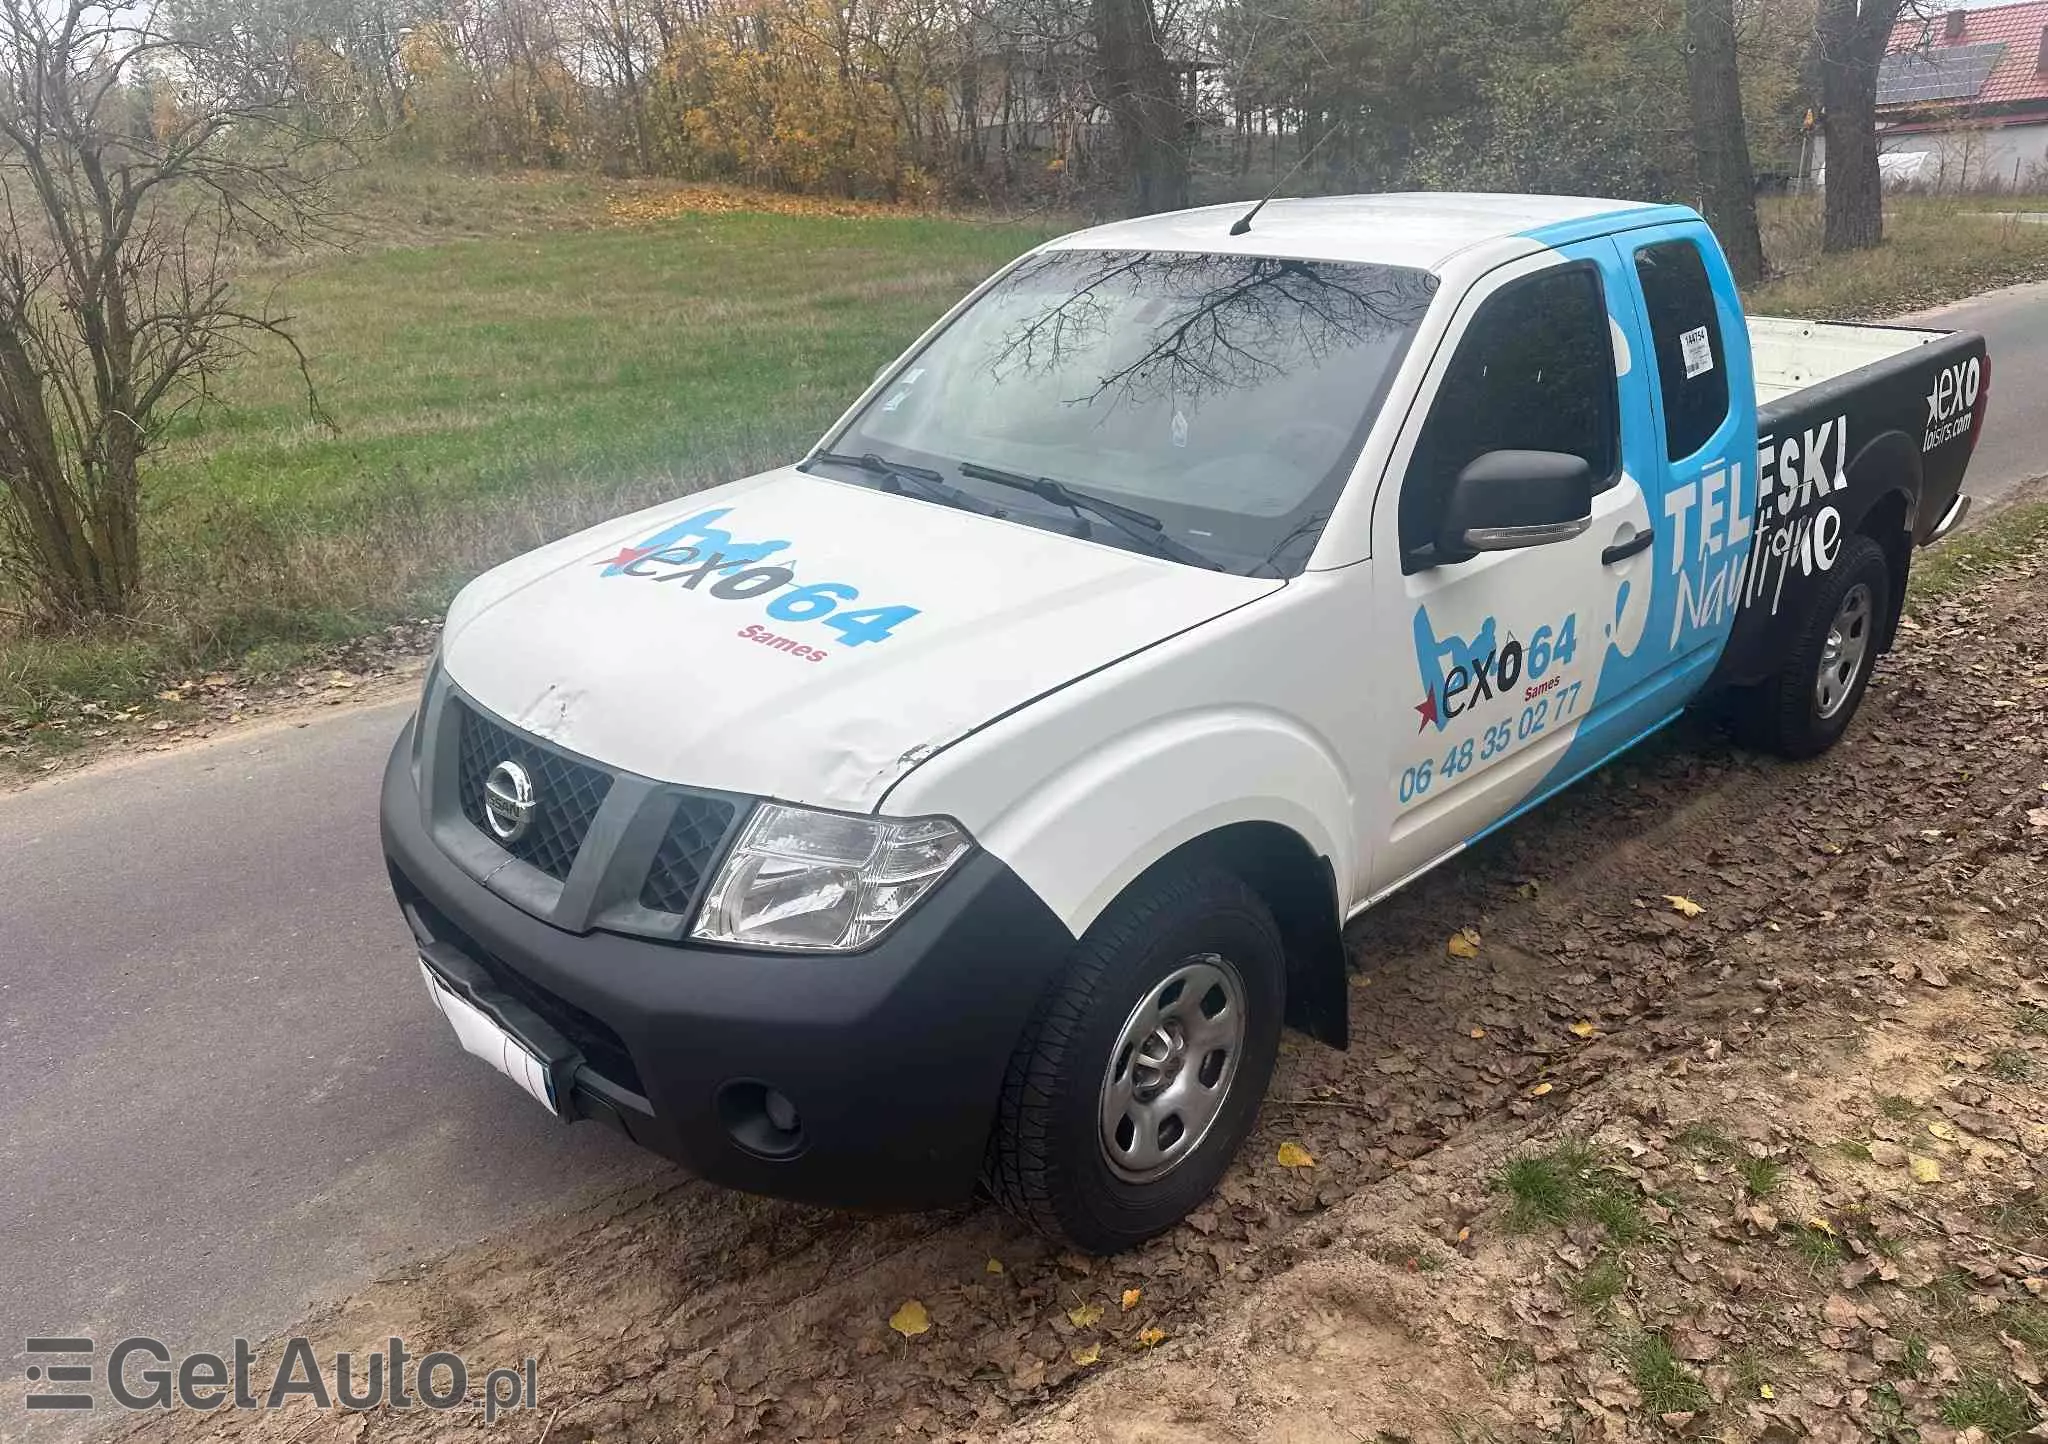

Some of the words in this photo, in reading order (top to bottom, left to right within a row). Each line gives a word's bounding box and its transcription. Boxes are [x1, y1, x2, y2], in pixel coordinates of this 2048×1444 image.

[1938, 356, 1980, 421] exo
[736, 624, 829, 663] Sames
[1526, 612, 1578, 680] 64
[1523, 673, 1561, 702] Sames
[1399, 757, 1435, 804] 06
[1439, 737, 1474, 779] 48
[1480, 717, 1513, 761] 35
[1517, 698, 1548, 741] 02
[1553, 680, 1583, 722] 77
